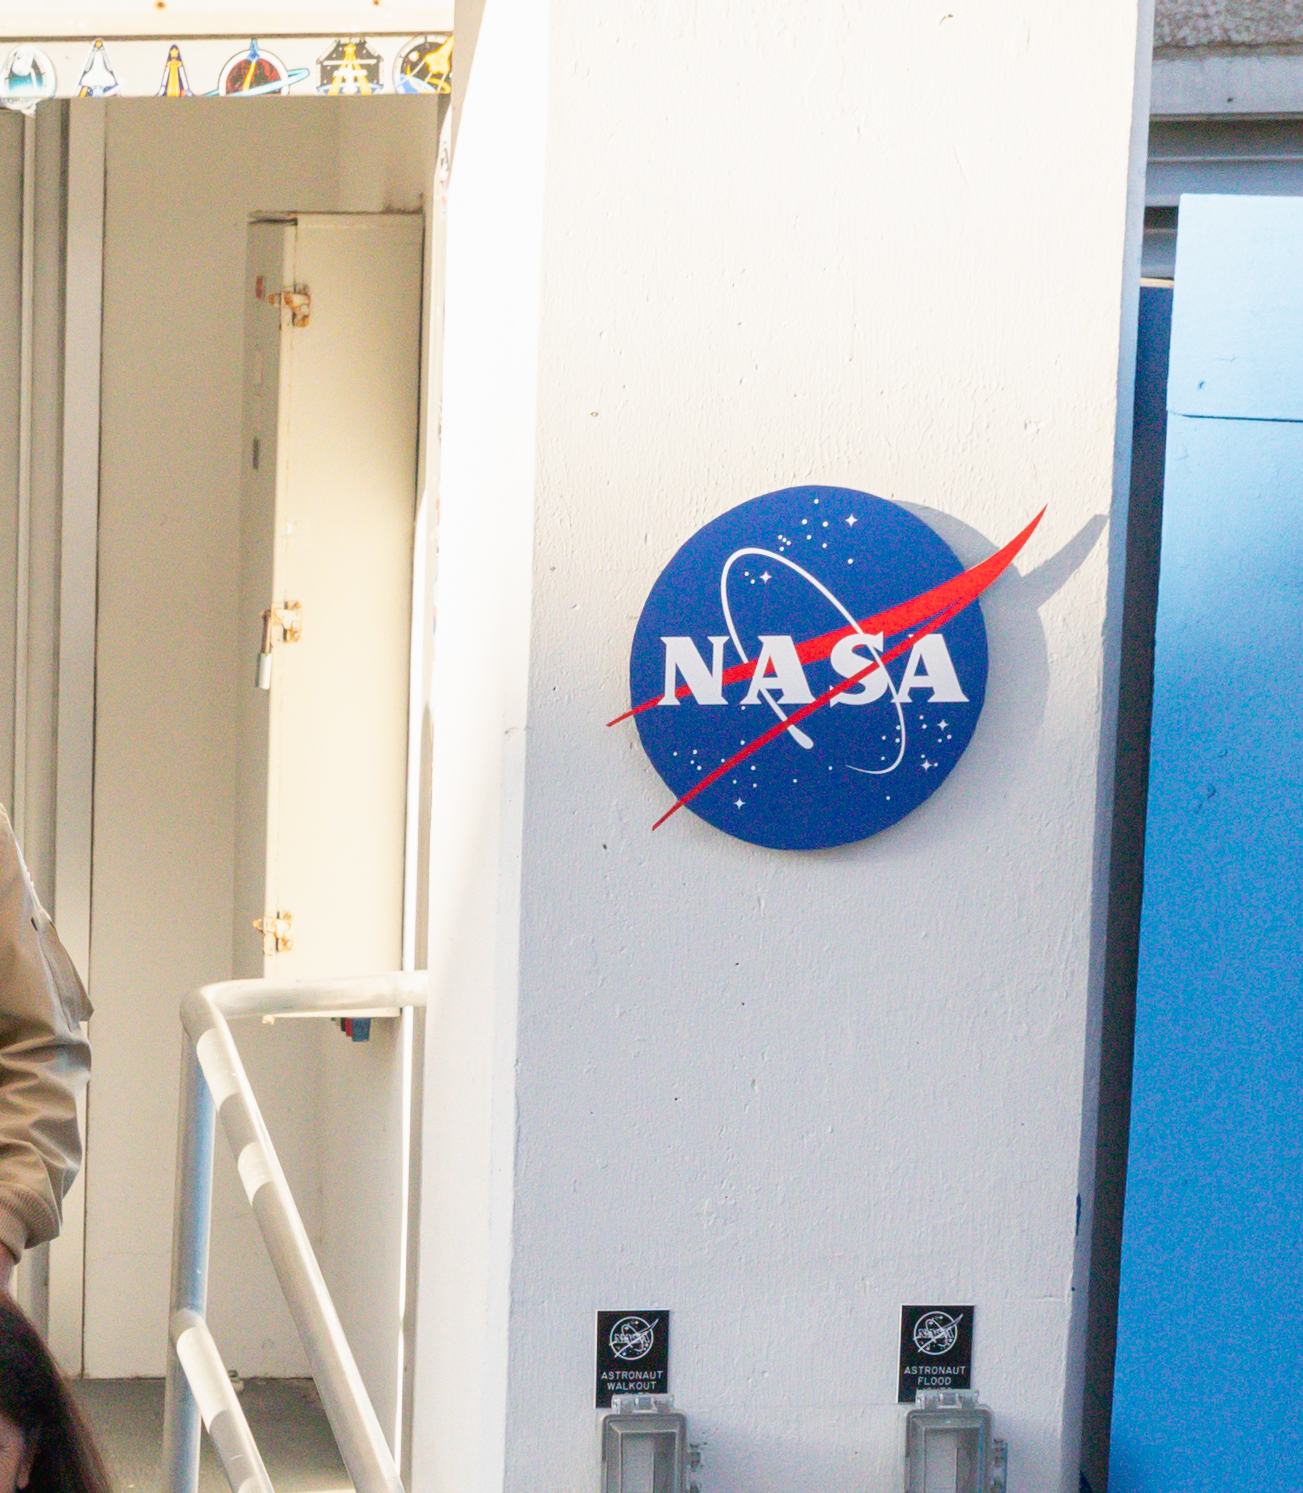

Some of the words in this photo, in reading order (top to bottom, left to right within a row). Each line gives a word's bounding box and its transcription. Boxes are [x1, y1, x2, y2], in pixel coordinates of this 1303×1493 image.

[657, 631, 970, 708] NASA
[601, 1370, 663, 1379] ASTRONAUT
[904, 1366, 966, 1375] ASTRONAUT
[917, 1376, 952, 1385] FLOOD
[607, 1381, 656, 1390] WALKOUT
